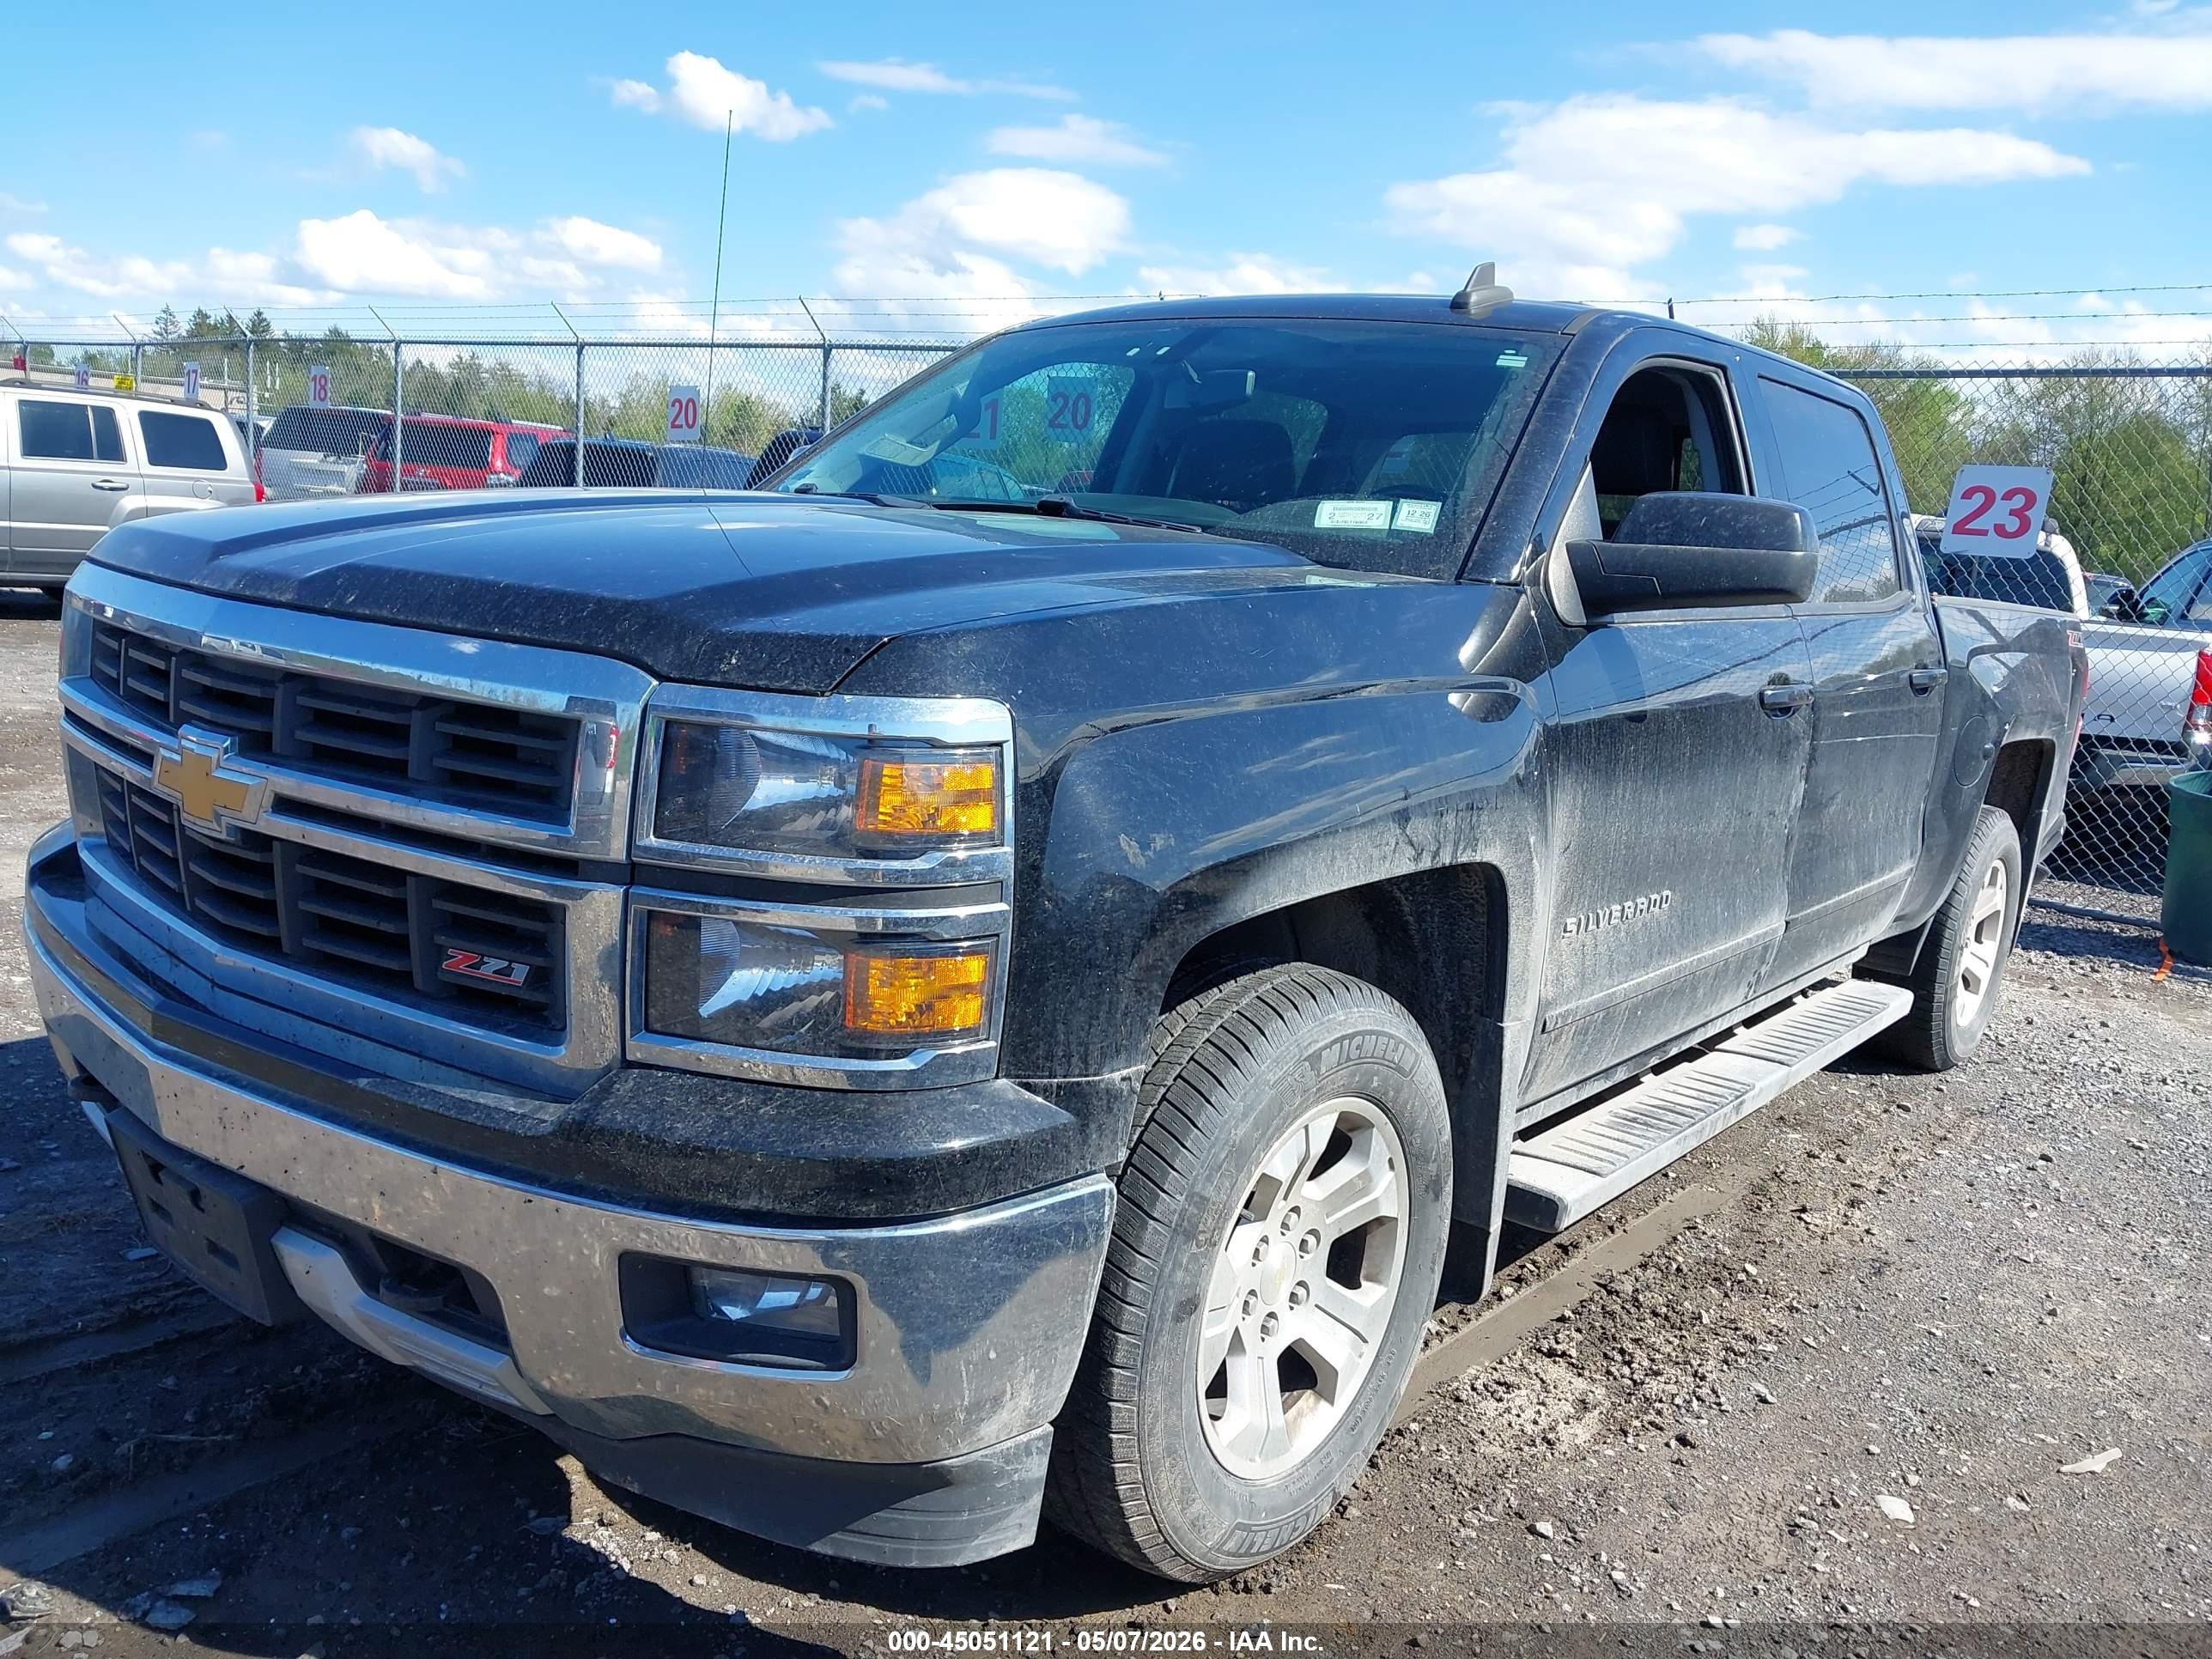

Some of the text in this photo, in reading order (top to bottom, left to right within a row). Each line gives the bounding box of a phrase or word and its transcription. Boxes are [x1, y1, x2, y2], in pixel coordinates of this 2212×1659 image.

[186, 369, 198, 394] 17
[311, 374, 330, 402] 18
[670, 398, 697, 429] 20
[1048, 392, 1091, 430] 20
[1951, 485, 2038, 539] 23
[1562, 890, 1672, 939] SILVERADO
[441, 948, 531, 987] Z71
[1320, 1035, 1419, 1079] MICHELIN
[1222, 1491, 1334, 1554] MICHELIN
